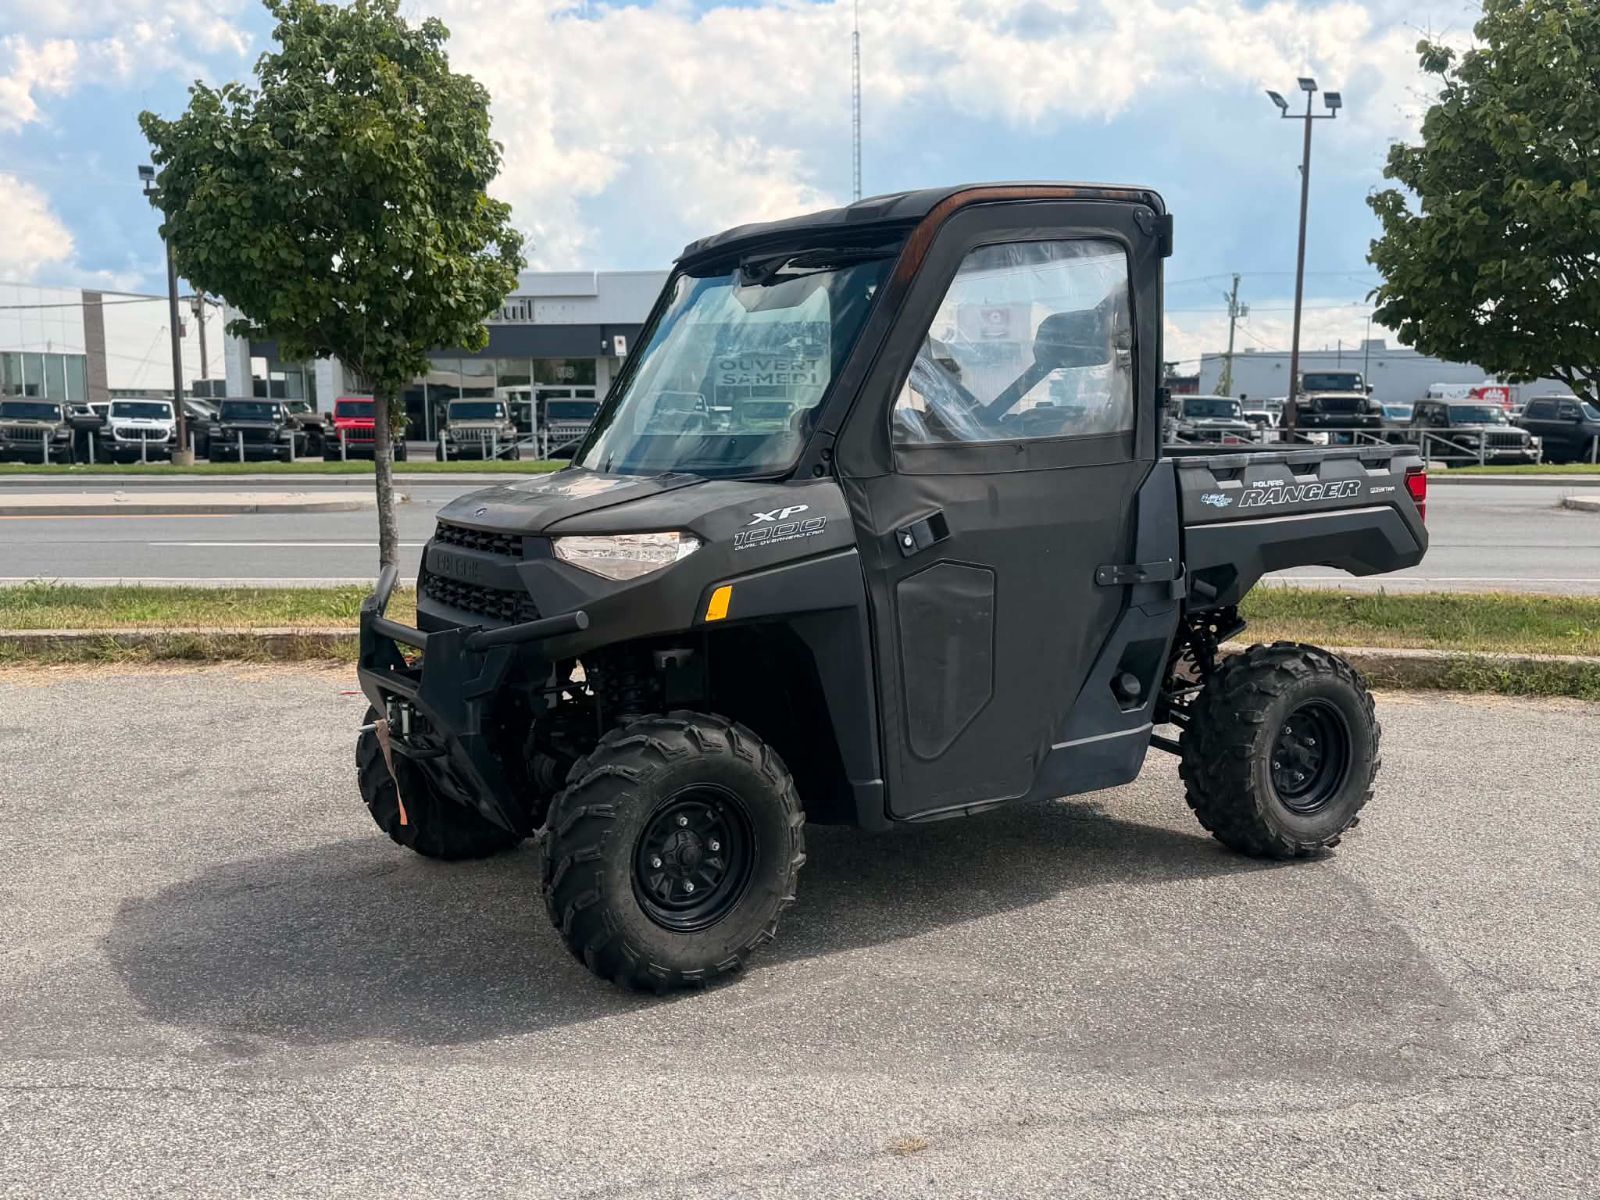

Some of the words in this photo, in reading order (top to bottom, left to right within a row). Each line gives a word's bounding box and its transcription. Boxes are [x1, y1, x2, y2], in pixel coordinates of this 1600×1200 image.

[720, 360, 818, 370] OUVERT
[722, 373, 817, 384] SAMEDI
[1238, 480, 1361, 507] RANGER
[1253, 480, 1284, 488] POLARIS
[747, 504, 809, 526] XP
[734, 516, 827, 545] 1000
[734, 543, 757, 551] DUAL
[760, 533, 805, 546] OVERHEAD
[806, 529, 824, 537] CAM
